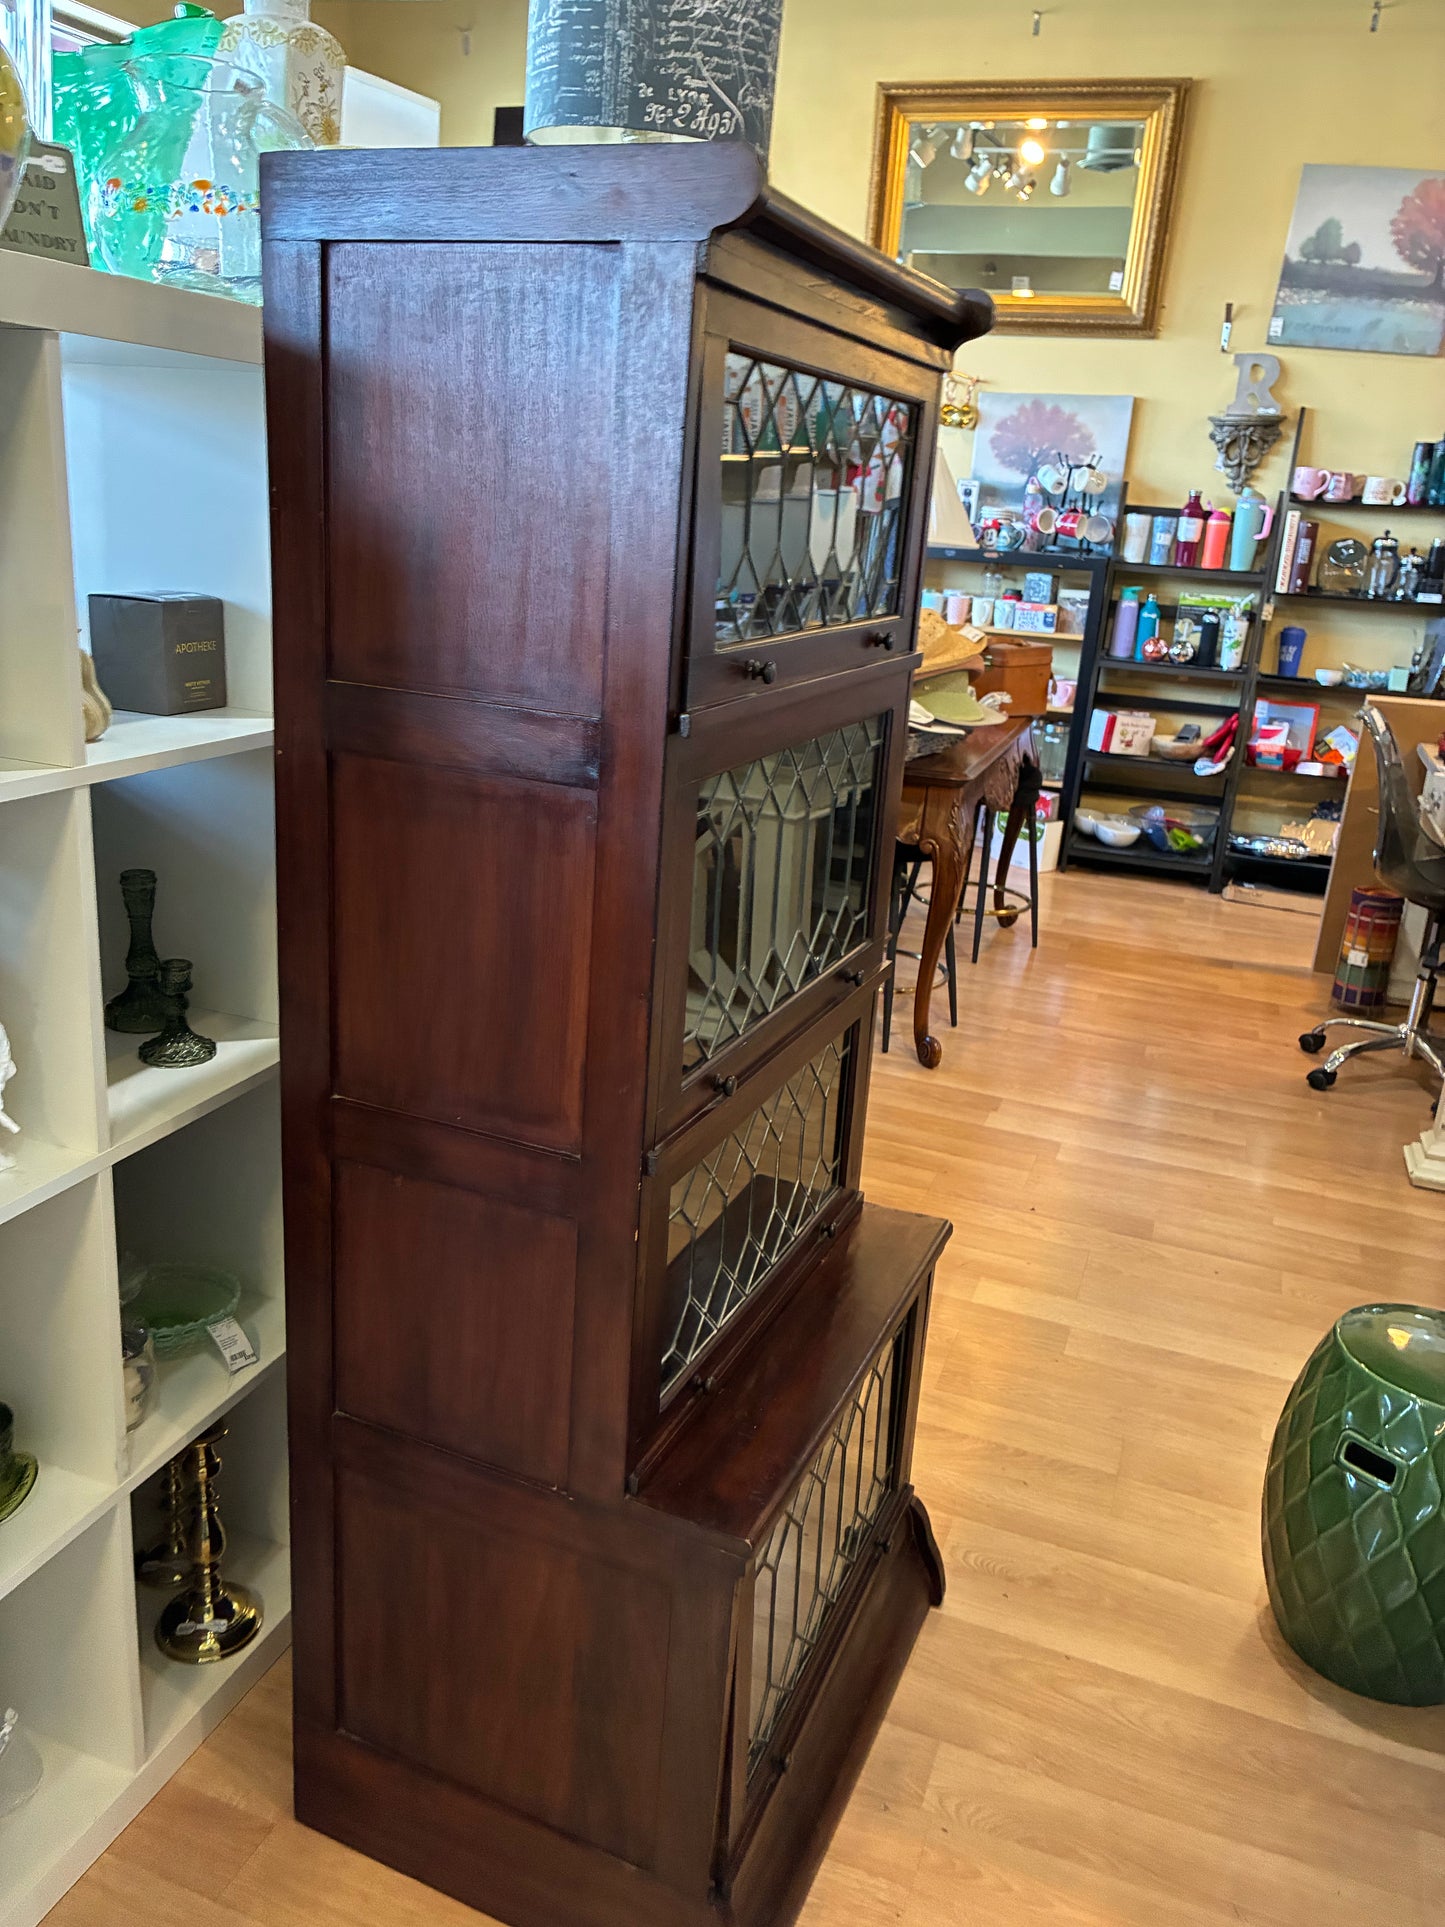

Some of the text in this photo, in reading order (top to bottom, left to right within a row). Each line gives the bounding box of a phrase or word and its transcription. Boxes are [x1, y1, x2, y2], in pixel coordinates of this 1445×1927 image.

[20, 174, 57, 191] AID
[1, 229, 78, 252] AUNDRY
[1226, 352, 1281, 416] R
[175, 640, 217, 655] APOTHEKE
